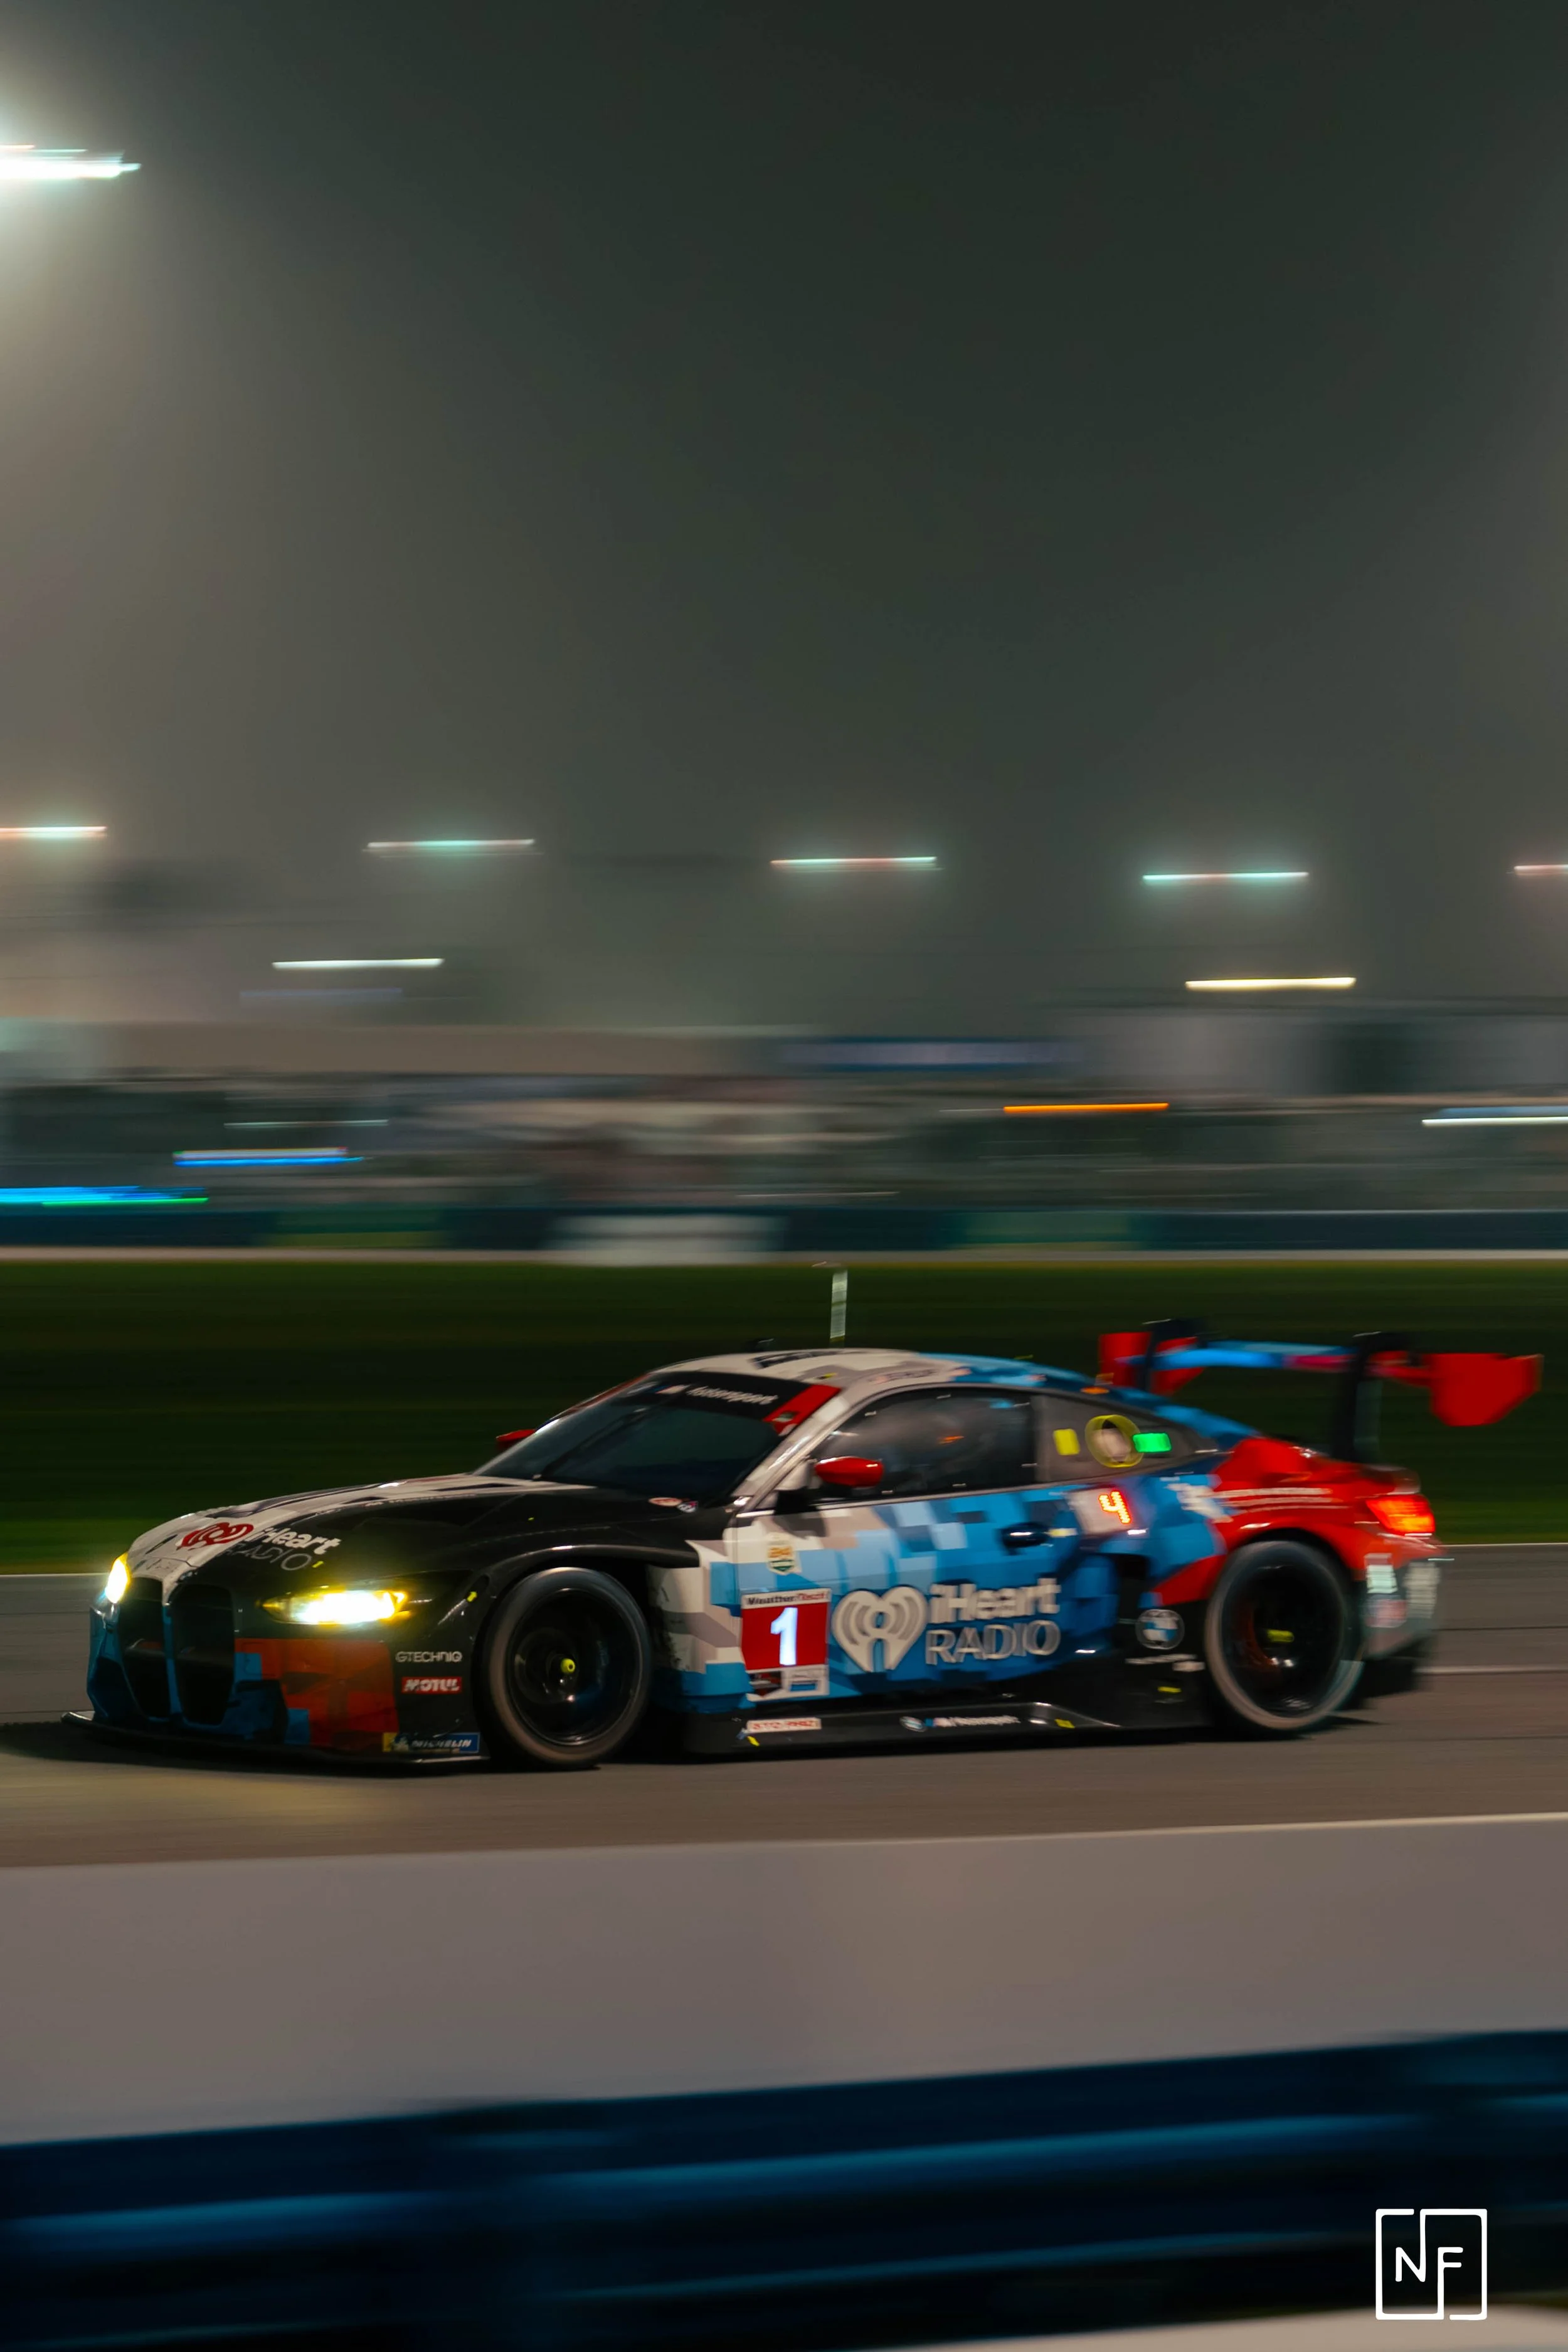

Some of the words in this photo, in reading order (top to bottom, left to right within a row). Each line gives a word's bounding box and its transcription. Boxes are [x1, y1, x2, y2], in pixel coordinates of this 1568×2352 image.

[1098, 1490, 1131, 1524] 4
[930, 1577, 1061, 1624] iHeart
[770, 1607, 798, 1666] 1
[925, 1619, 1061, 1666] RADIO
[404, 1678, 460, 1692] MOTUL
